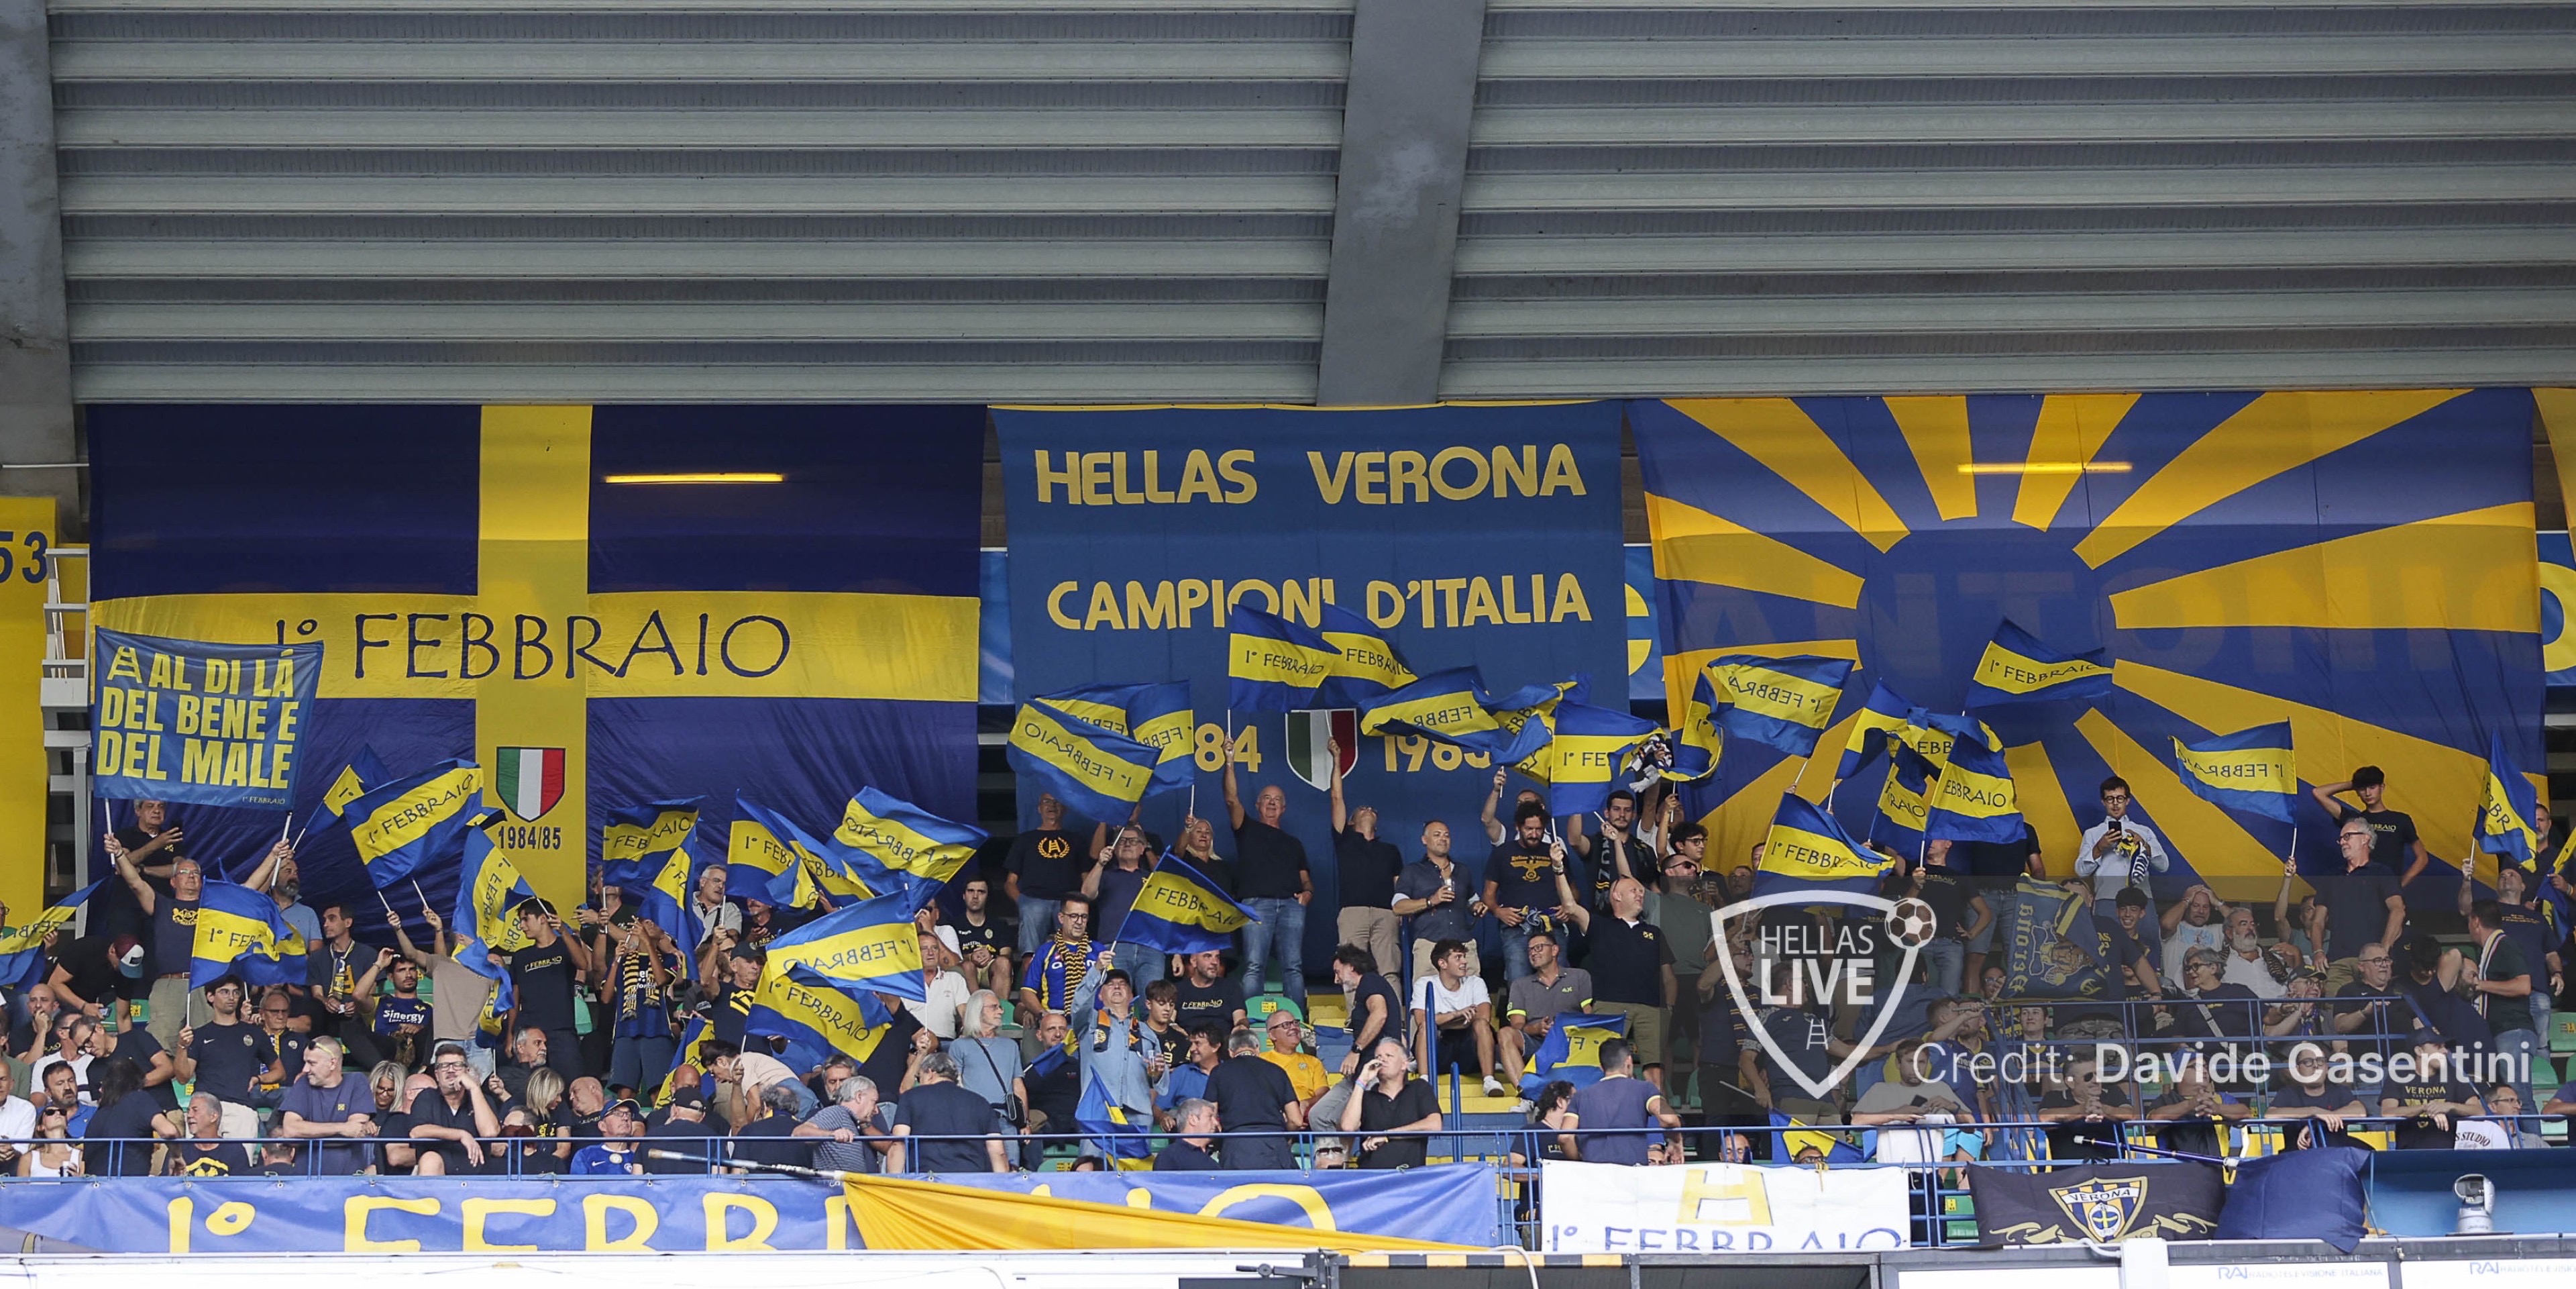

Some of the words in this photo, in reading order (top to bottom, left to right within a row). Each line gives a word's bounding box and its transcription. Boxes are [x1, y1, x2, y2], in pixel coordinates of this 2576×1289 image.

[1036, 449, 1258, 505] HELLAS
[1307, 443, 1587, 505] VERONA
[1366, 572, 1592, 629] D'ITALIA
[355, 609, 790, 680] FEBBRAIO
[148, 652, 192, 691] AL
[204, 658, 241, 695] DI
[1264, 654, 1324, 674] FEBBRAIO
[100, 686, 164, 732] DEL
[176, 694, 268, 741] BENE
[277, 701, 299, 741] E
[95, 730, 168, 780] DEL
[180, 737, 293, 789] MALE
[382, 774, 474, 835] FEBBRAIO
[1943, 779, 2006, 808] EBBRAIO
[498, 825, 561, 850] 1984/85
[383, 1009, 425, 1025] Sinergy
[786, 988, 871, 1042] FEBBRAIO
[2405, 1086, 2446, 1094] VERONA
[2461, 1131, 2491, 1147] STUDIO
[2070, 1188, 2131, 1202] VERONA
[2218, 1266, 2248, 1280] RAI
[2469, 1262, 2500, 1275] RAI
